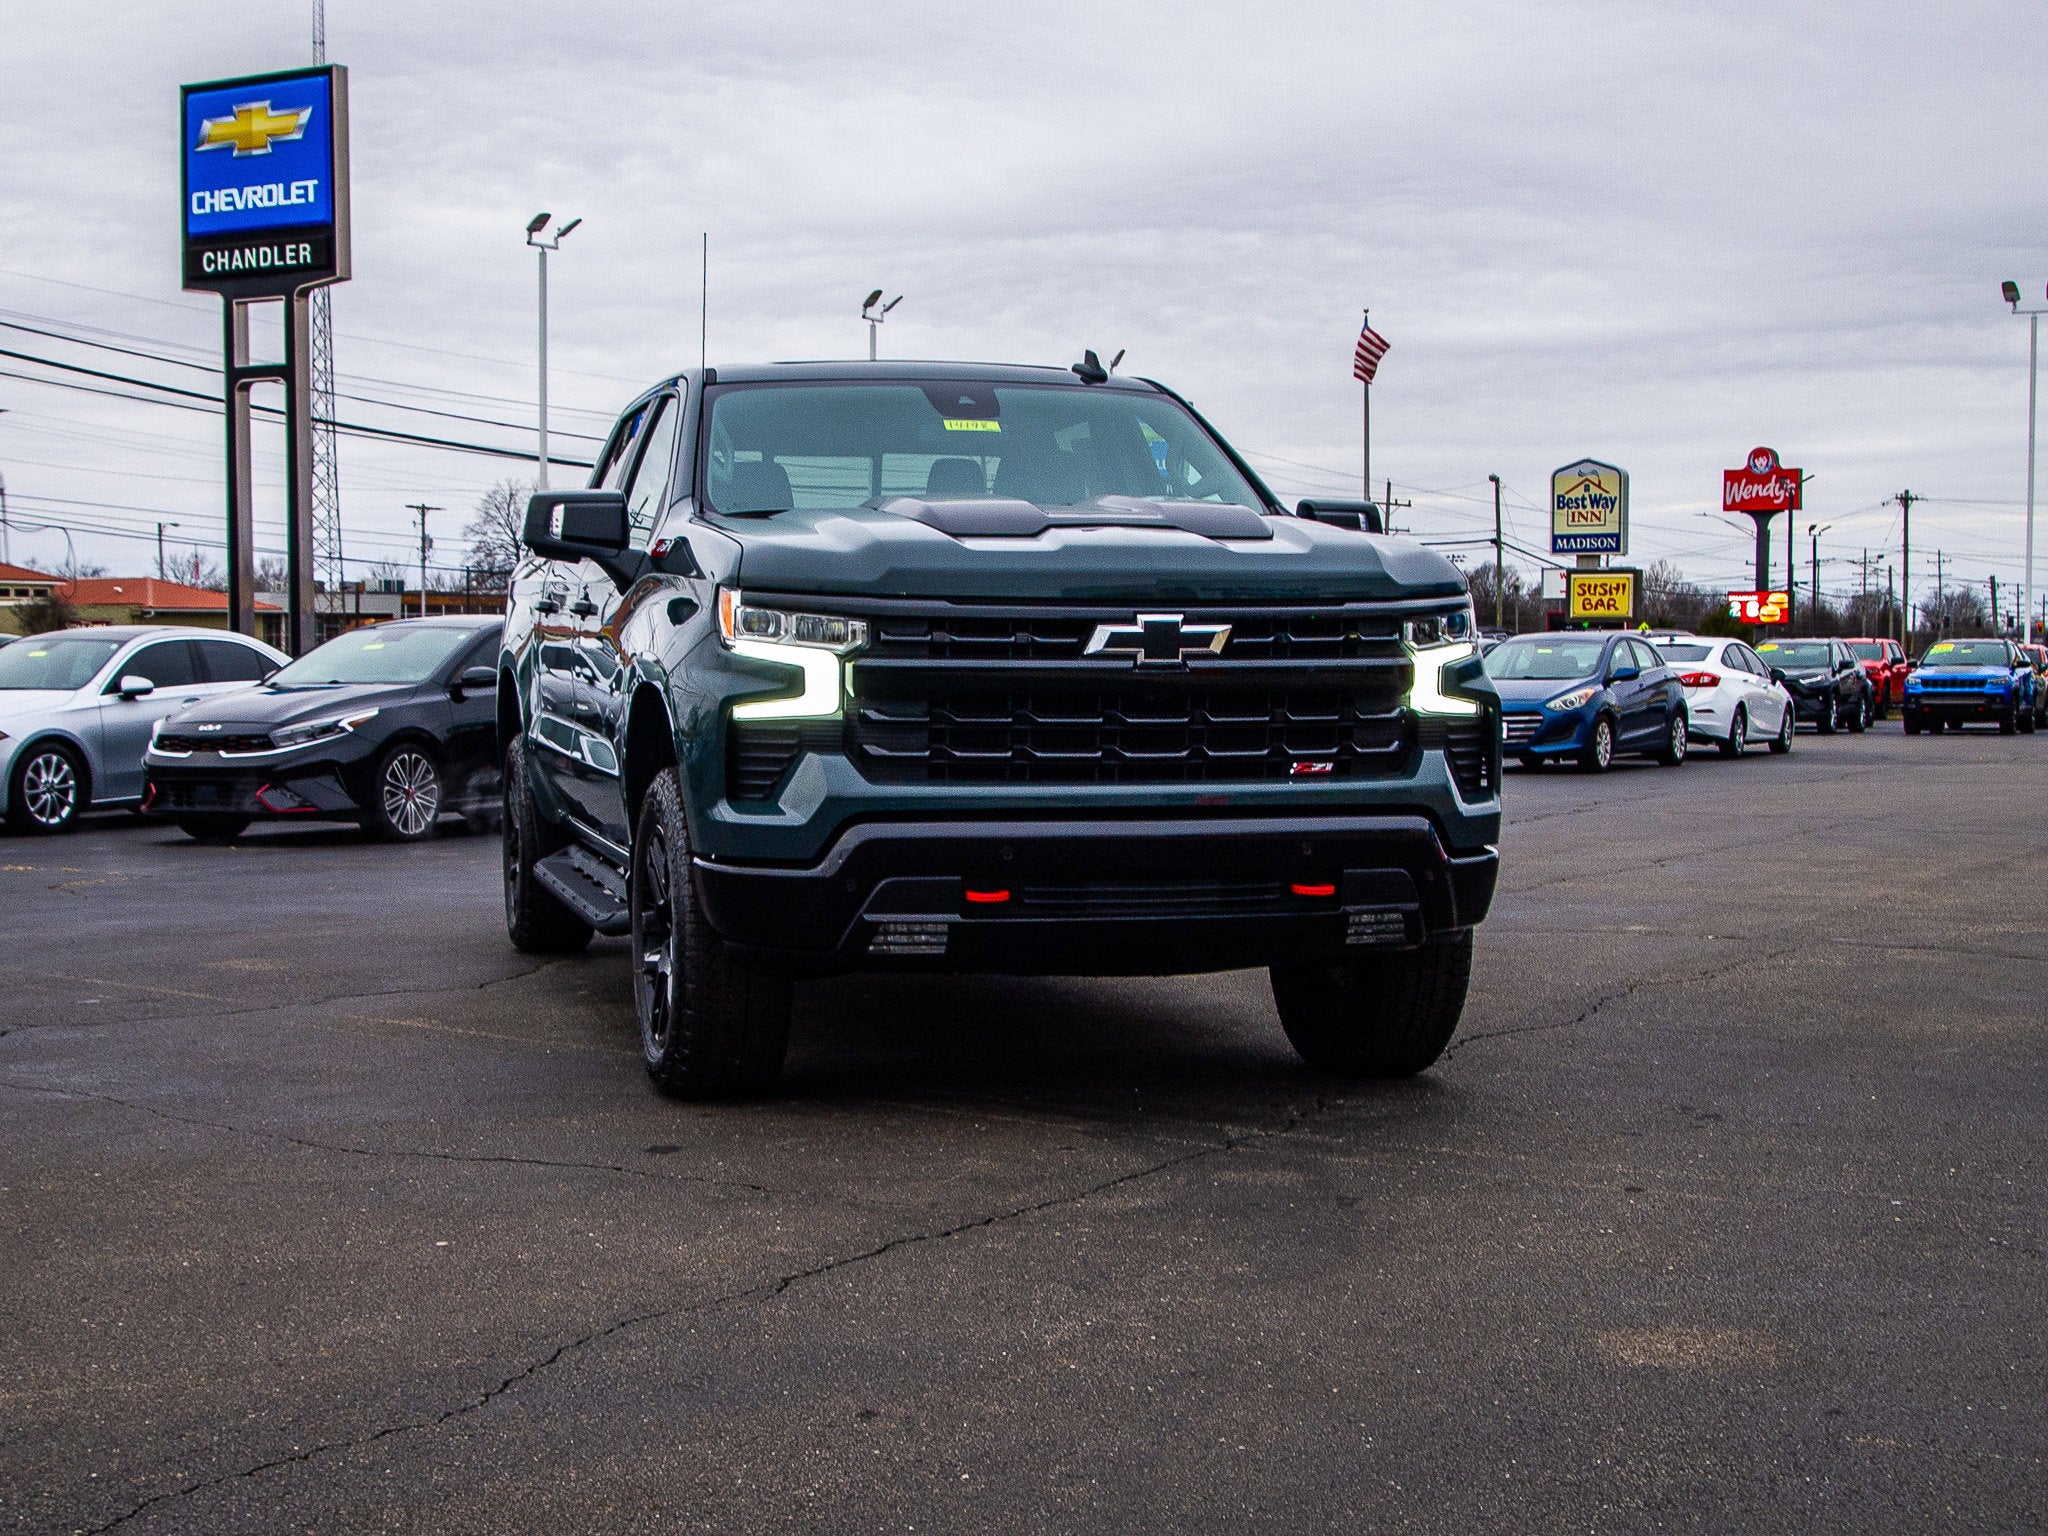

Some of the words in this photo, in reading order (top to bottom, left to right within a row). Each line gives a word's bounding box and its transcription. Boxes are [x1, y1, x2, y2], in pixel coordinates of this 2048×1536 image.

[191, 179, 319, 214] CHEVROLET
[202, 243, 312, 272] CHANDLER
[1556, 493, 1588, 511] Best
[1589, 493, 1618, 514] Way
[1571, 511, 1602, 523] INN
[1556, 537, 1617, 550] MADISON
[1576, 583, 1627, 596] SUSHI
[1581, 597, 1620, 611] BAR
